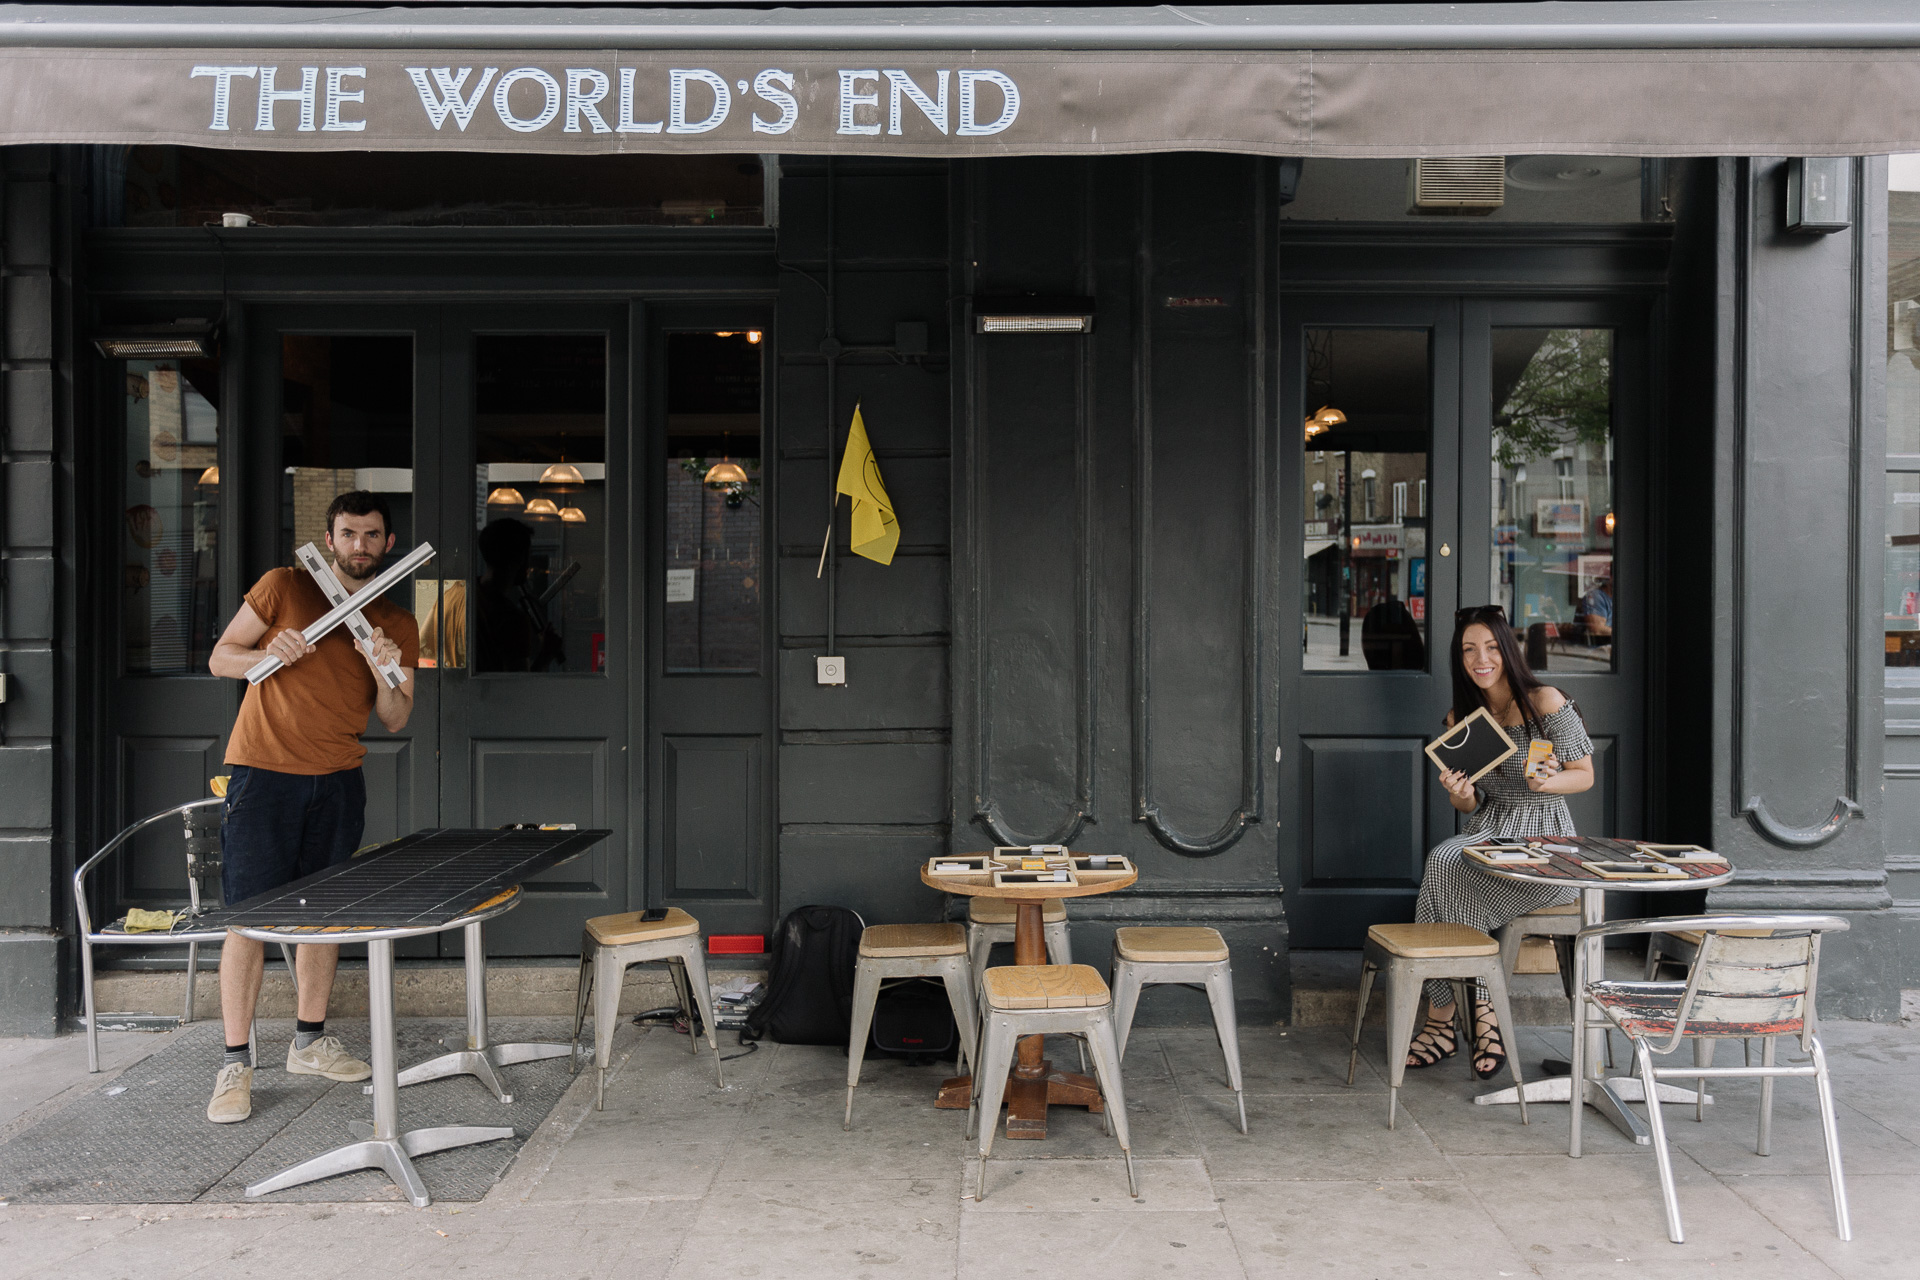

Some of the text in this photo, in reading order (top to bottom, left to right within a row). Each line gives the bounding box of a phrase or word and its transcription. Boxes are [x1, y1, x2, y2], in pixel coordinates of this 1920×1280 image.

[188, 64, 1021, 138] THE WORLD'S END
